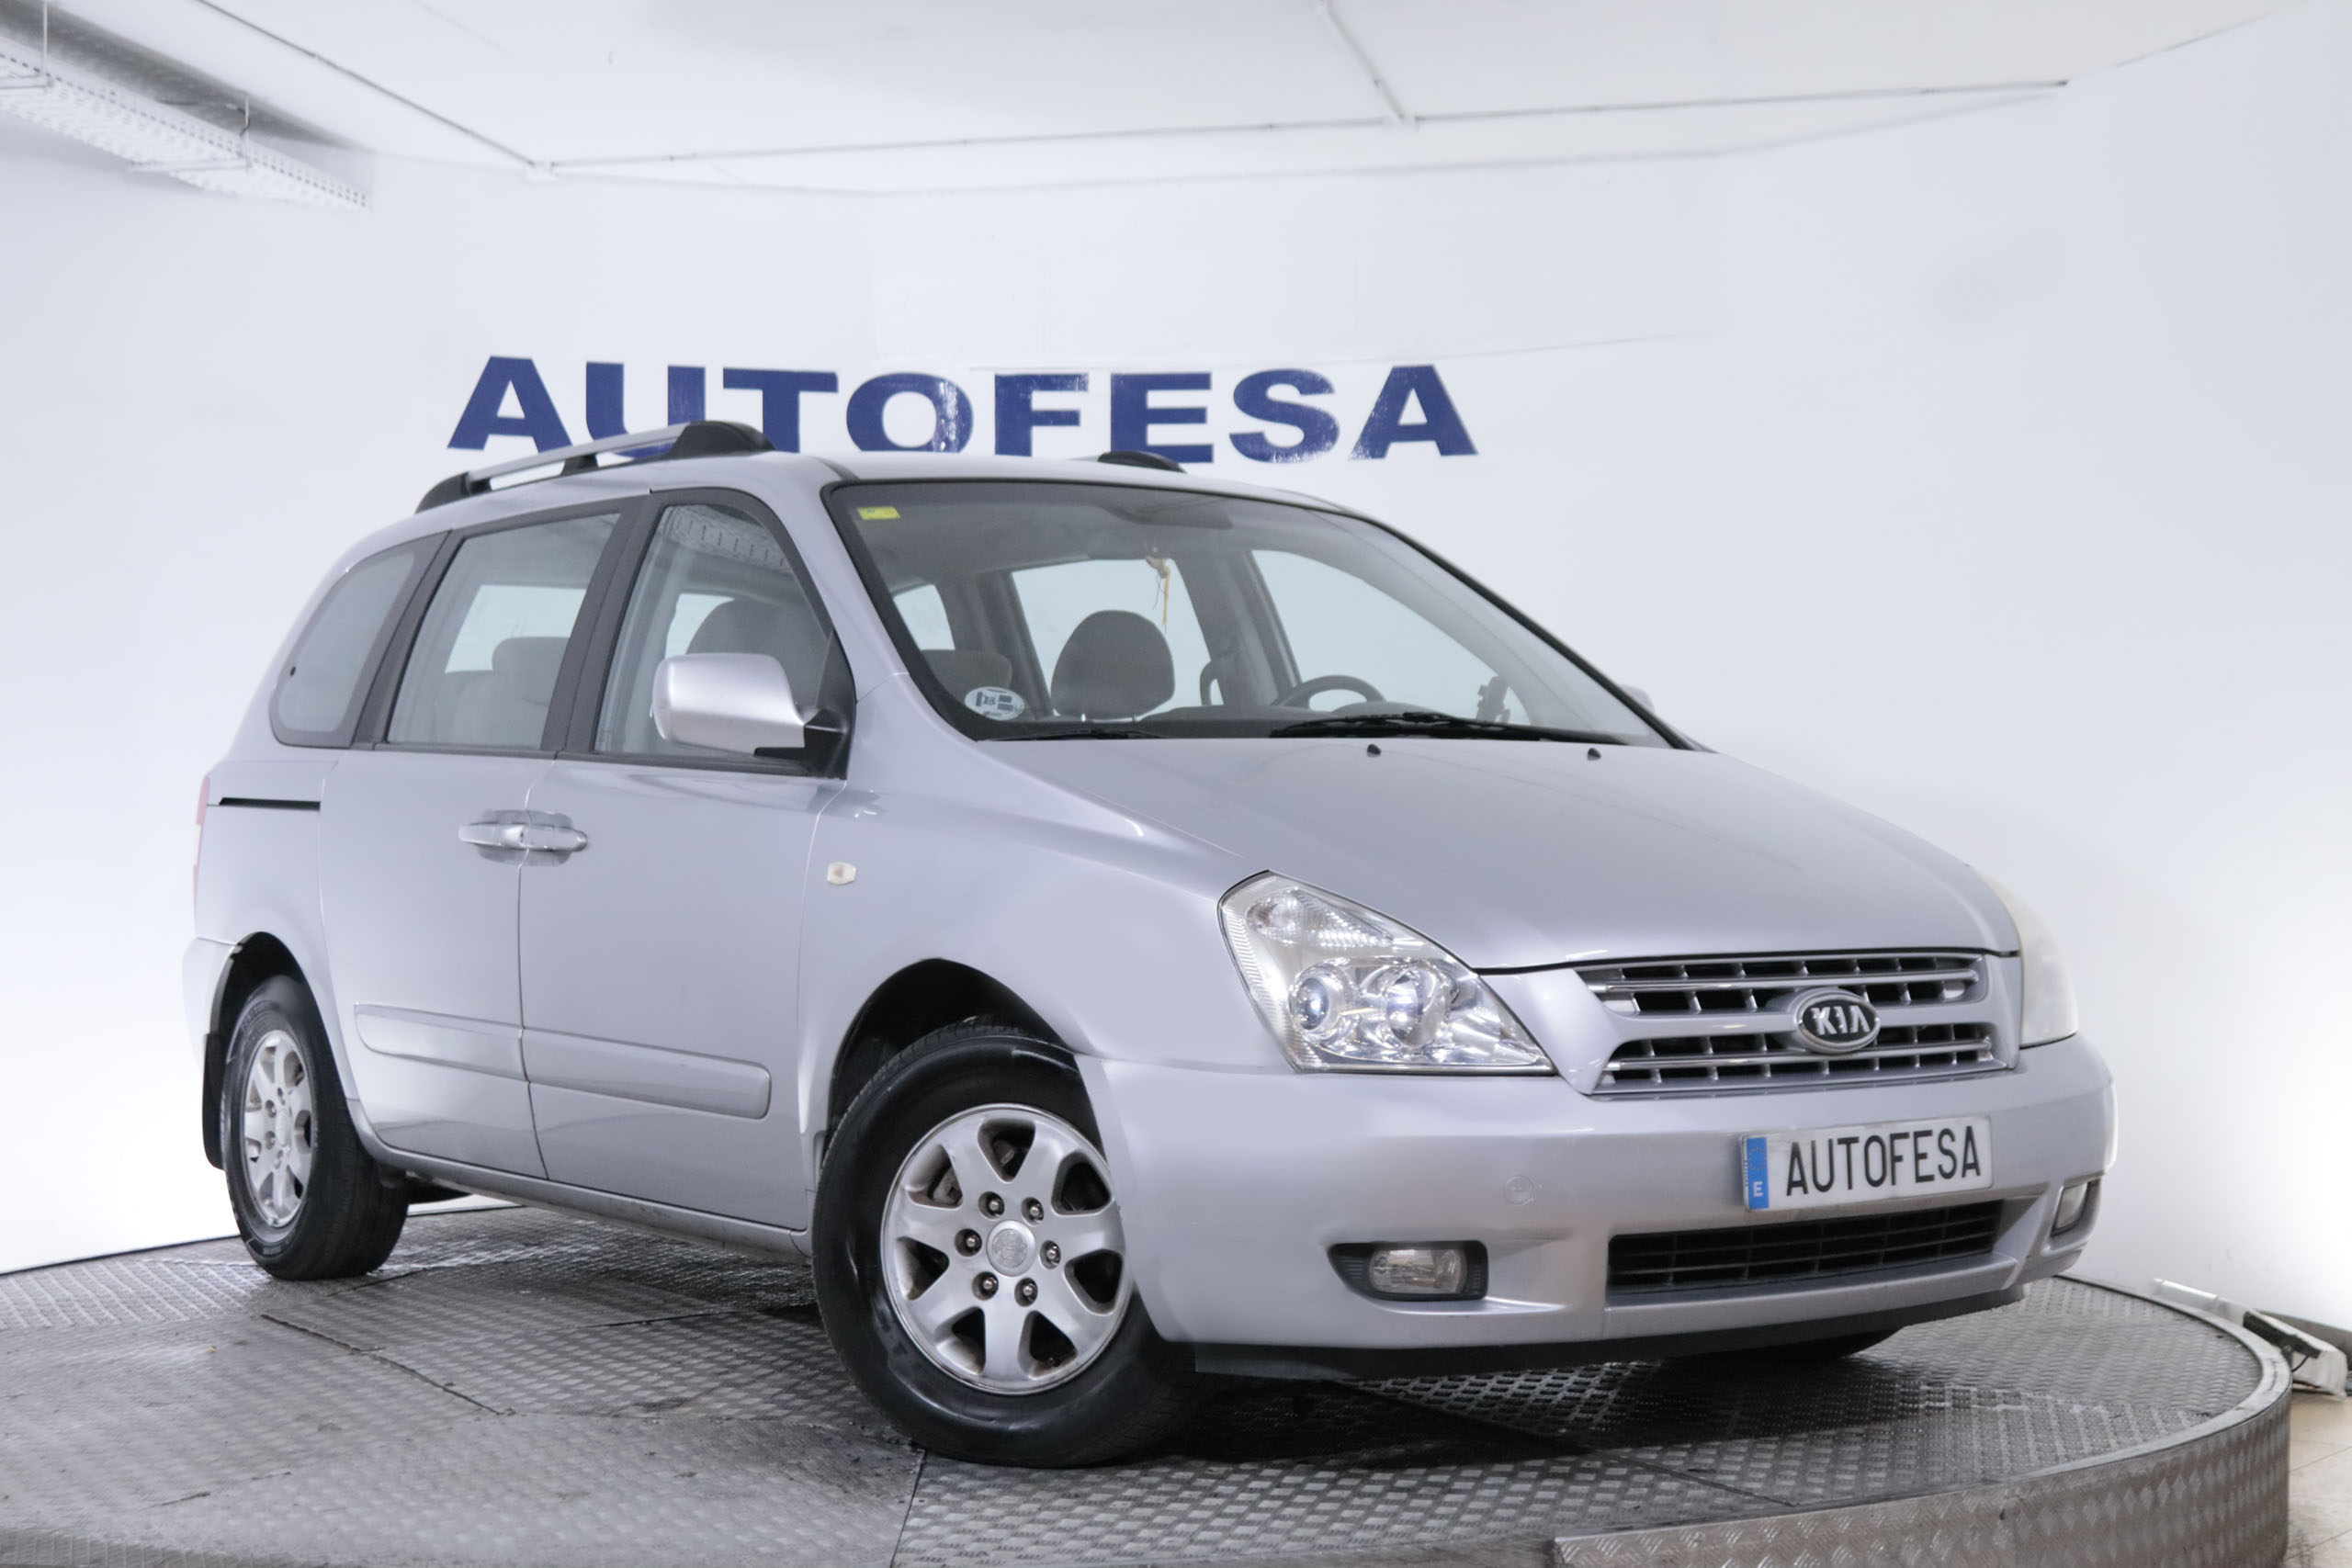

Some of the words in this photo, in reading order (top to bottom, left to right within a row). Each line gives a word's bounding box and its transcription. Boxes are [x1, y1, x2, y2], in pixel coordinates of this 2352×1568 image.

[447, 355, 1478, 464] AUTOFESA
[1810, 1005, 1871, 1035] KIA
[1752, 1180, 1764, 1197] E
[1786, 1125, 1982, 1197] AUTOFESA
